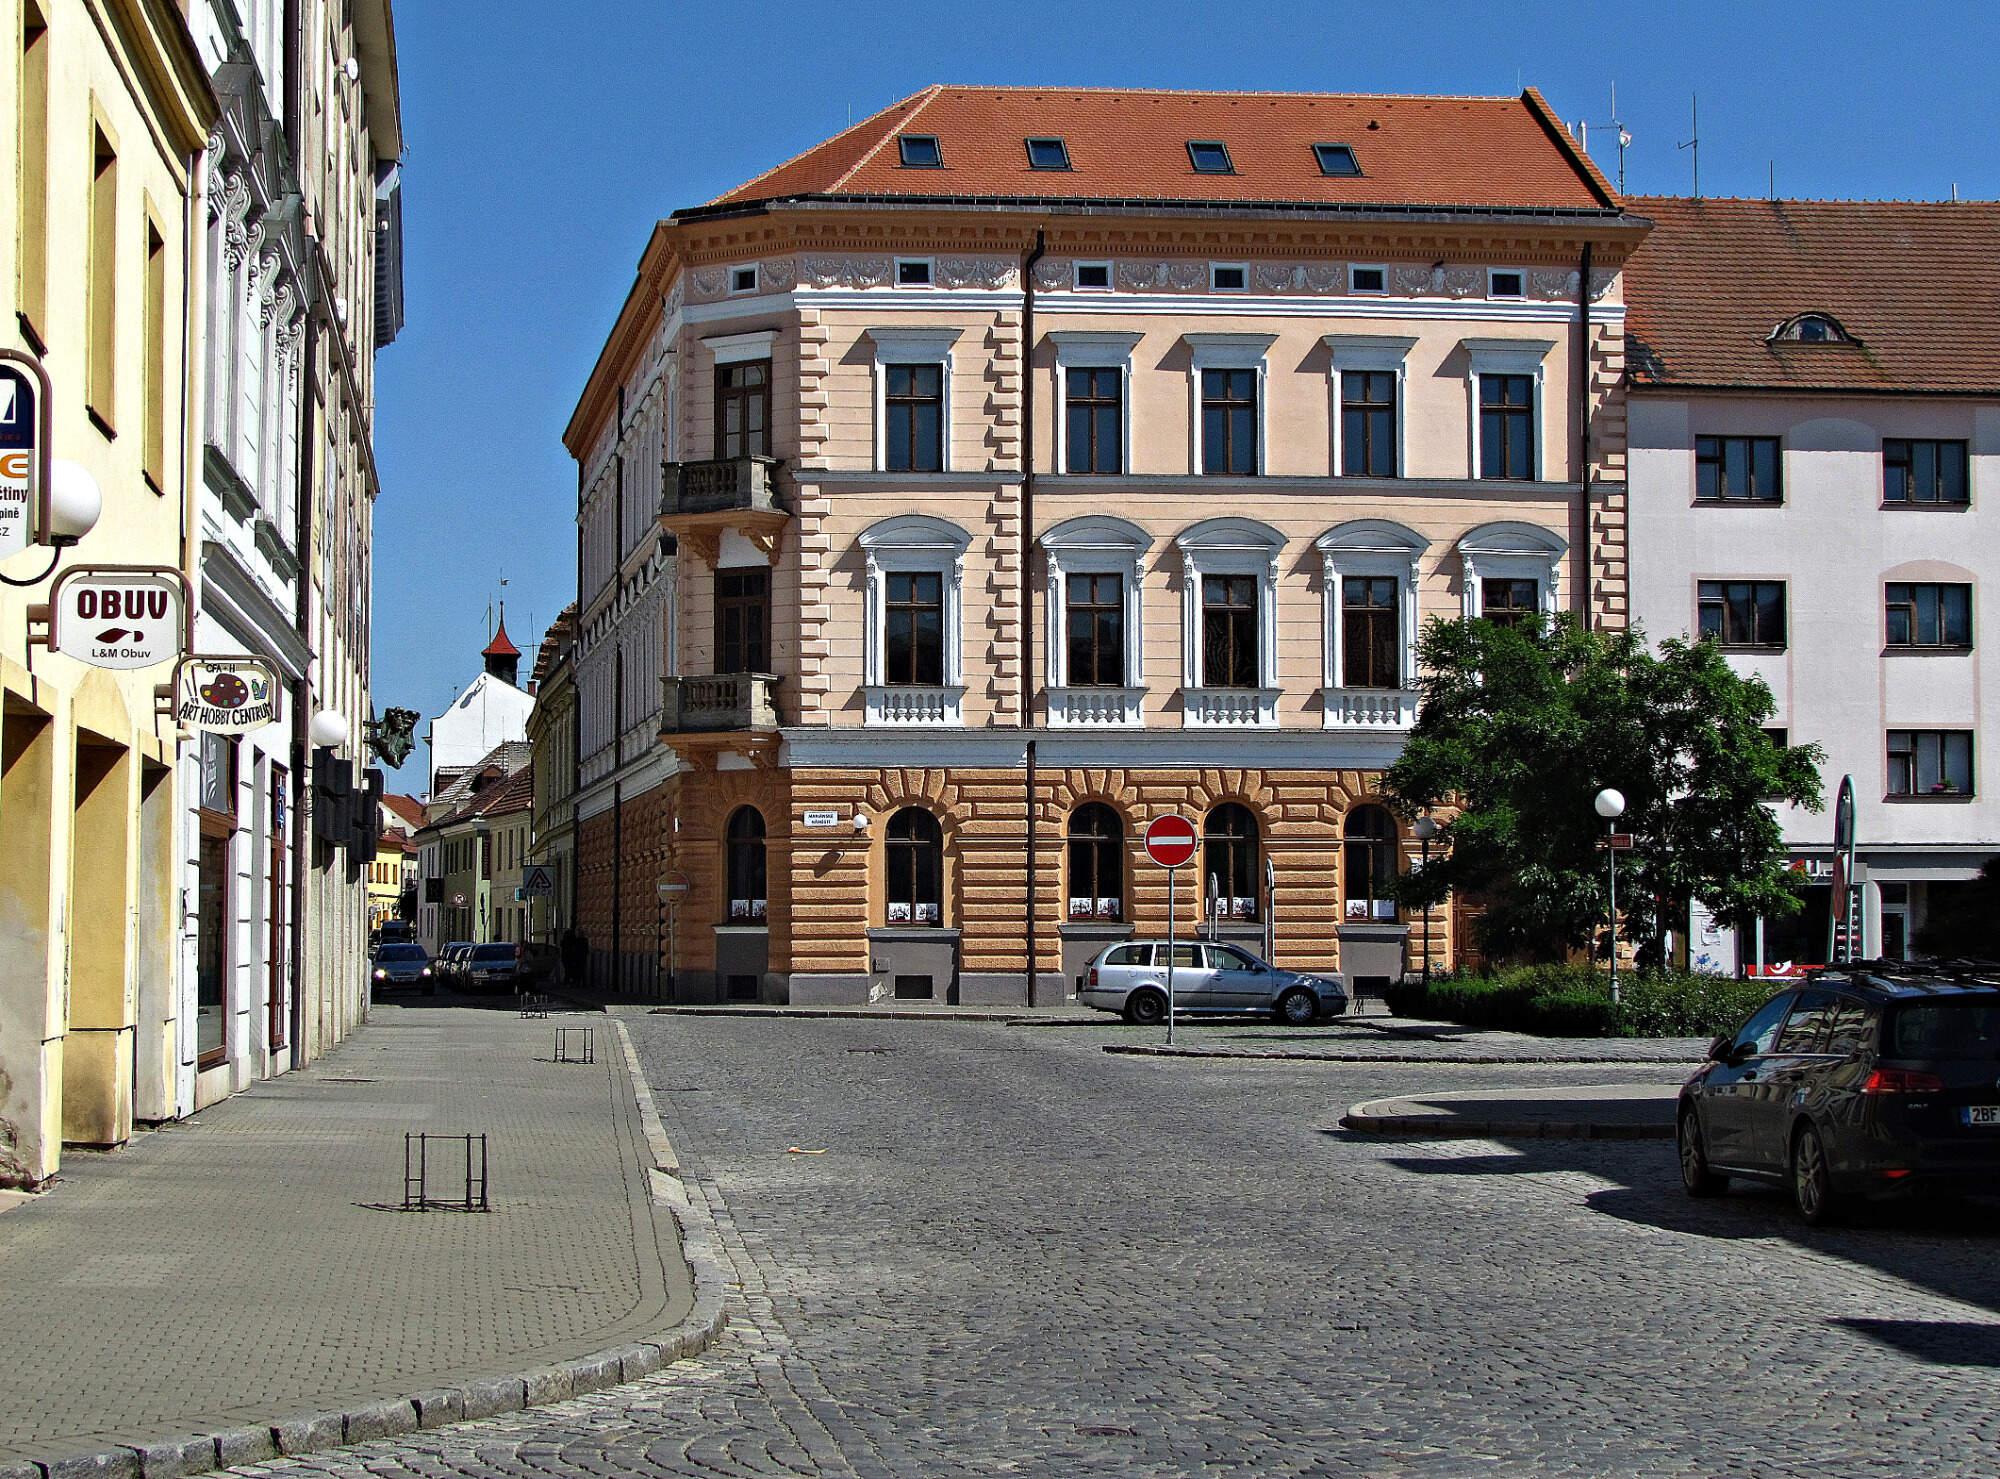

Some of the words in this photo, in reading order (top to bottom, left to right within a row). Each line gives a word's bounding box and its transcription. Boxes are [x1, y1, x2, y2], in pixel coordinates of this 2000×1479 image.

[77, 589, 168, 620] OBUV
[92, 648, 118, 658] L&M
[120, 648, 151, 658] Obuv
[180, 702, 200, 721] ART
[199, 706, 231, 725] HOBBY
